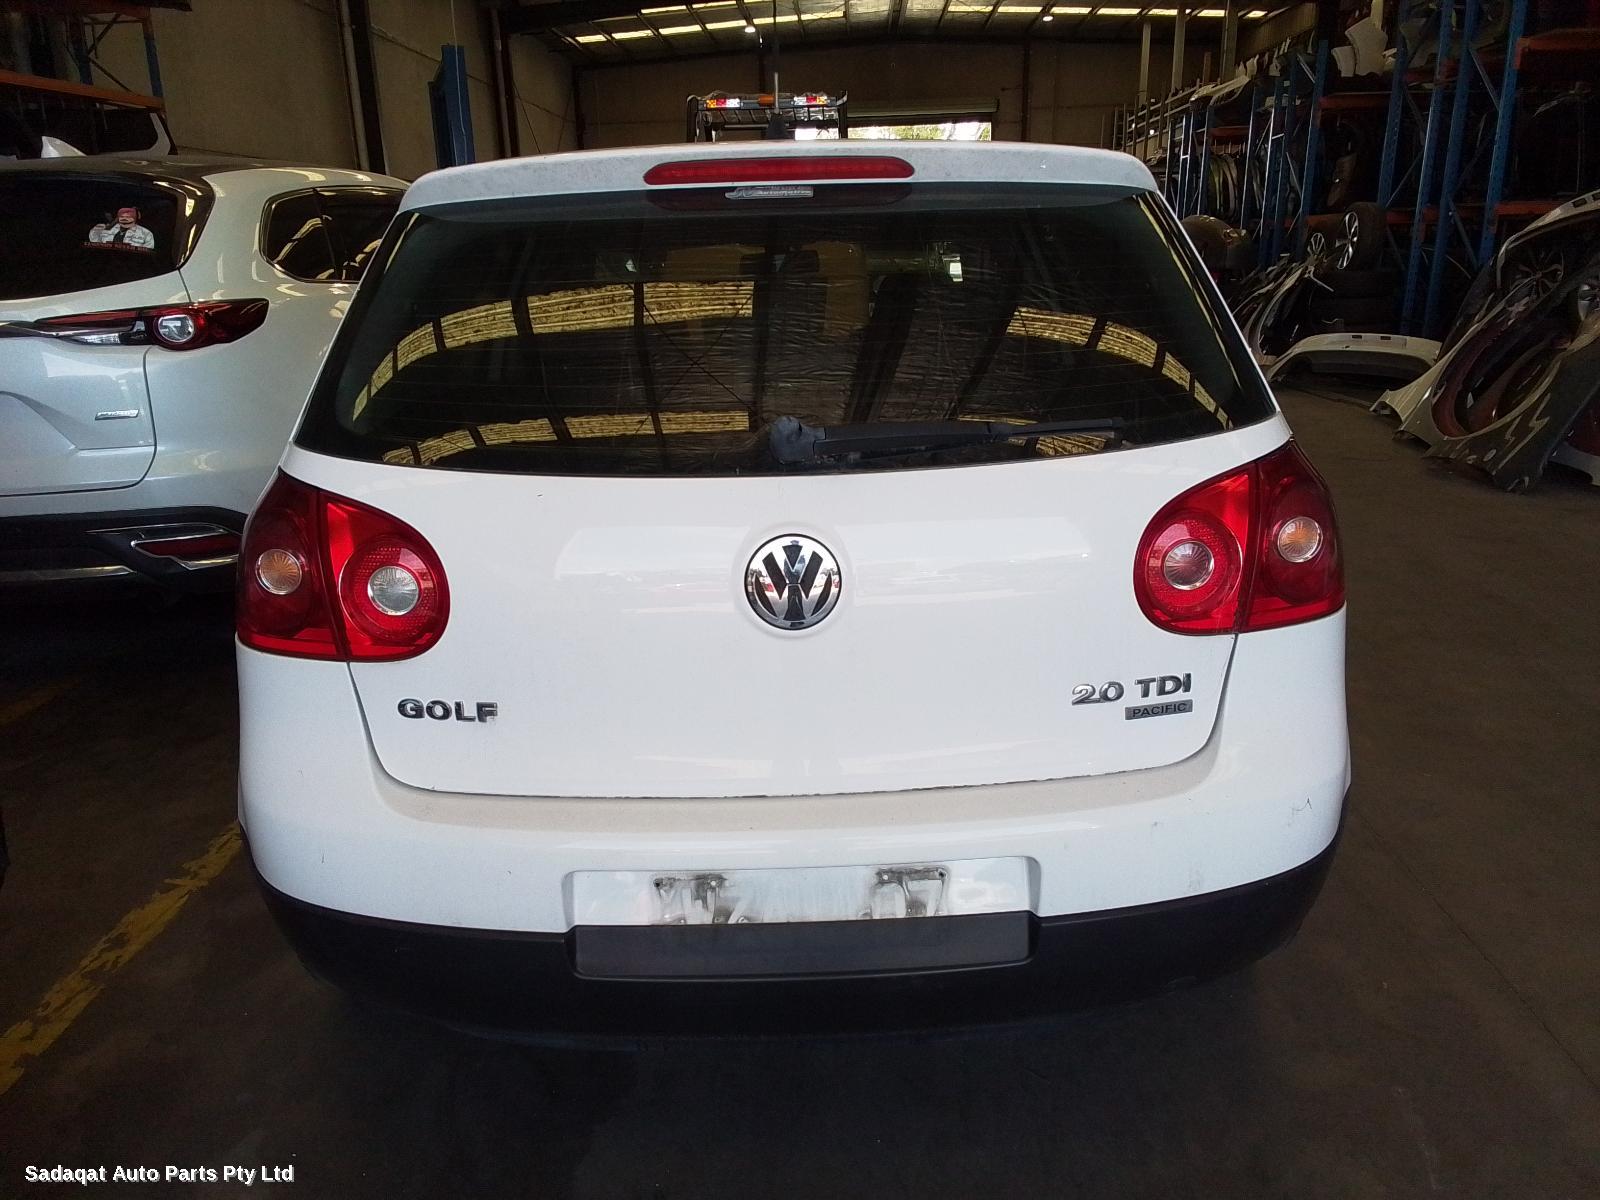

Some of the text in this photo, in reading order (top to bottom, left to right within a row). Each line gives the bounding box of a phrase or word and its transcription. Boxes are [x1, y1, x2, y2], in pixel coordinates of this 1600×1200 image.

[1135, 672, 1192, 698] TDI
[397, 698, 498, 723] GOLF
[1132, 702, 1188, 718] PACIFIC
